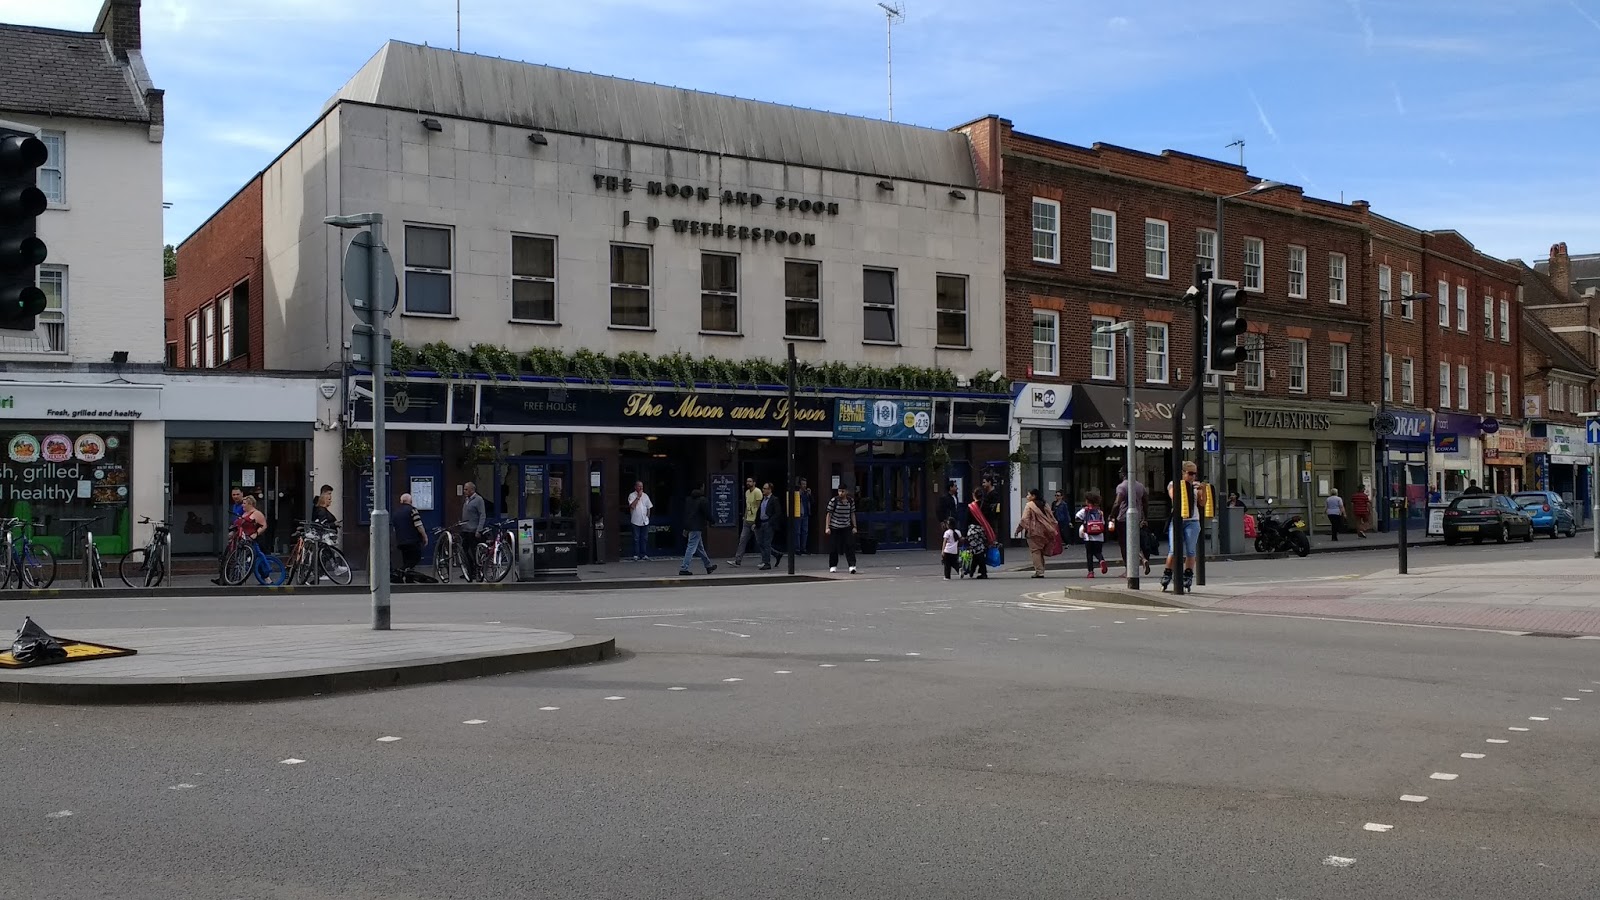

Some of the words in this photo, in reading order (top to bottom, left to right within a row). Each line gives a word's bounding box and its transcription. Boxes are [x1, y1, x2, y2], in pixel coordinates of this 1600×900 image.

[593, 174, 633, 193] THE
[647, 180, 709, 201] MOON
[722, 190, 763, 207] AND
[775, 196, 839, 216] SPOON
[647, 216, 660, 231] D
[672, 219, 816, 246] WETHERSPOON
[0, 395, 13, 408] ri
[524, 401, 544, 411] FREE
[545, 402, 577, 412] HOUSE
[623, 393, 663, 417] The
[669, 395, 724, 419] Moon
[730, 398, 771, 420] and
[47, 409, 70, 417] Fresh,
[72, 409, 97, 418] grilled
[114, 410, 142, 418] healthy
[839, 412, 866, 422] FESTIVAL
[1393, 416, 1420, 437] ORAL
[23, 463, 84, 483] grilled,
[10, 484, 75, 504] healthy
